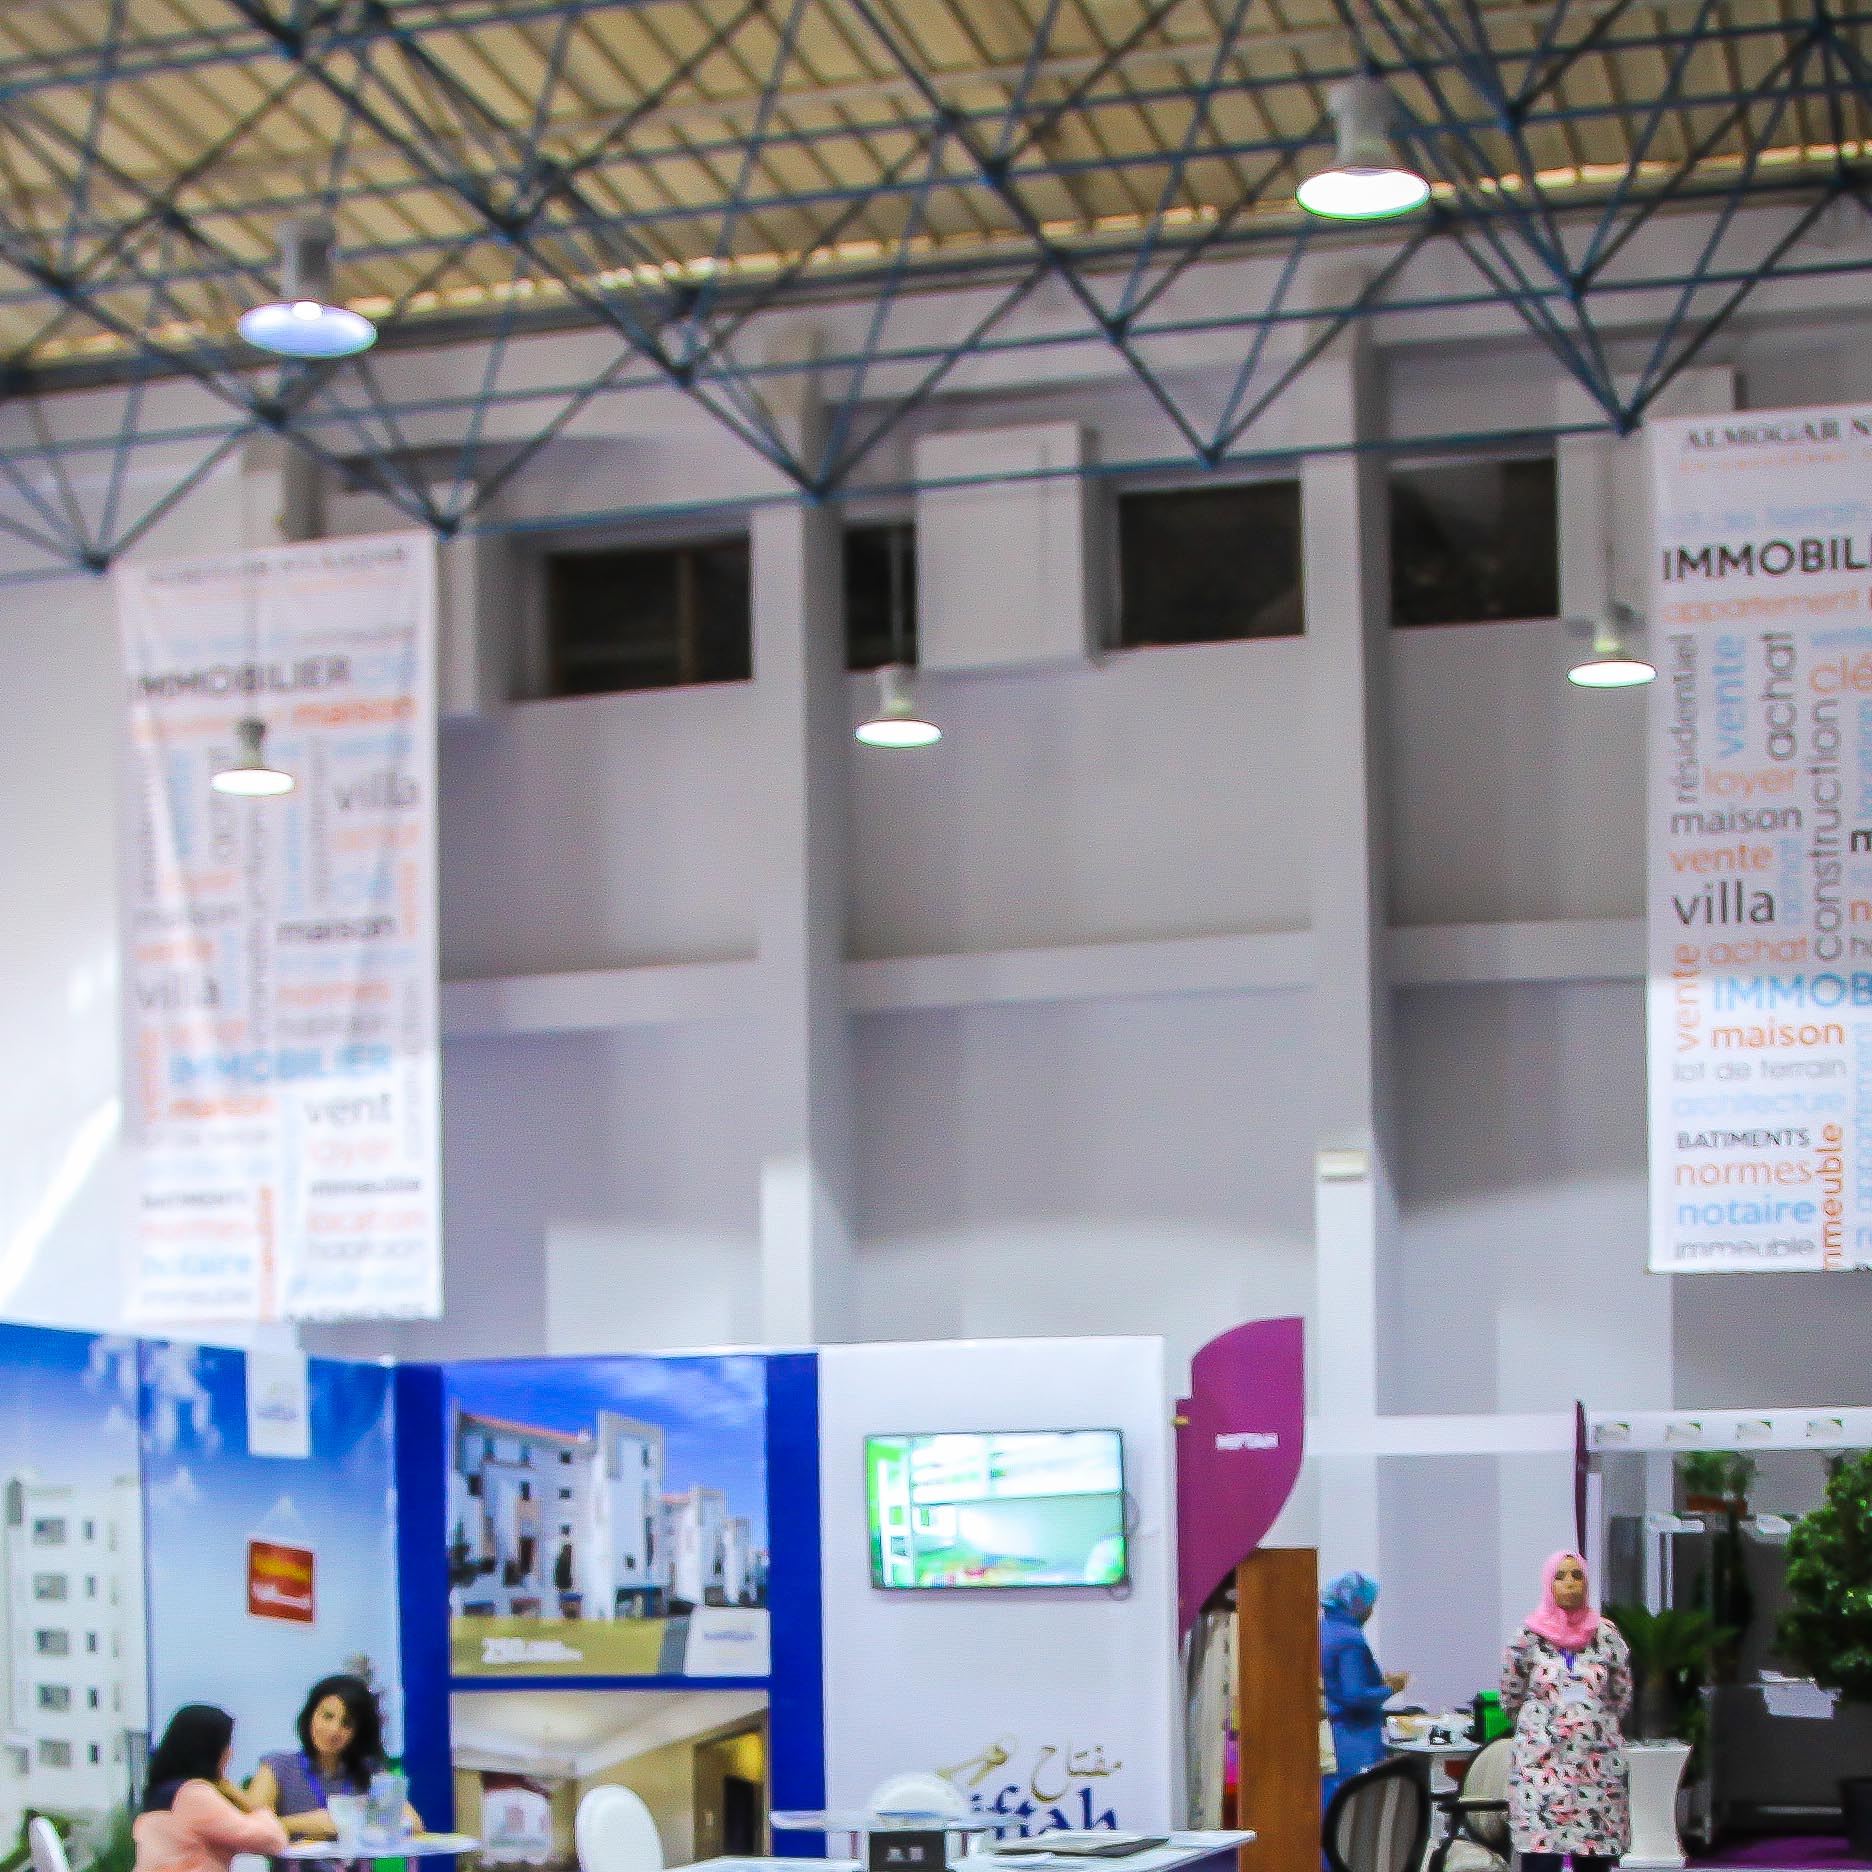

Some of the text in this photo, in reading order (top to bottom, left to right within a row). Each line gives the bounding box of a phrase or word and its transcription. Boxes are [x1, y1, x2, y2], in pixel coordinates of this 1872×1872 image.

[1759, 631, 1797, 762] achat
[1670, 804, 1804, 836] maison
[1808, 697, 1843, 961] construction
[1668, 842, 1775, 874] vente
[1671, 878, 1776, 926] villa
[1672, 942, 1701, 1054] vente
[1710, 1015, 1846, 1051] maison
[1674, 1156, 1813, 1187] normes
[1676, 1195, 1817, 1227] notaire
[1816, 1121, 1844, 1271] mmeuble
